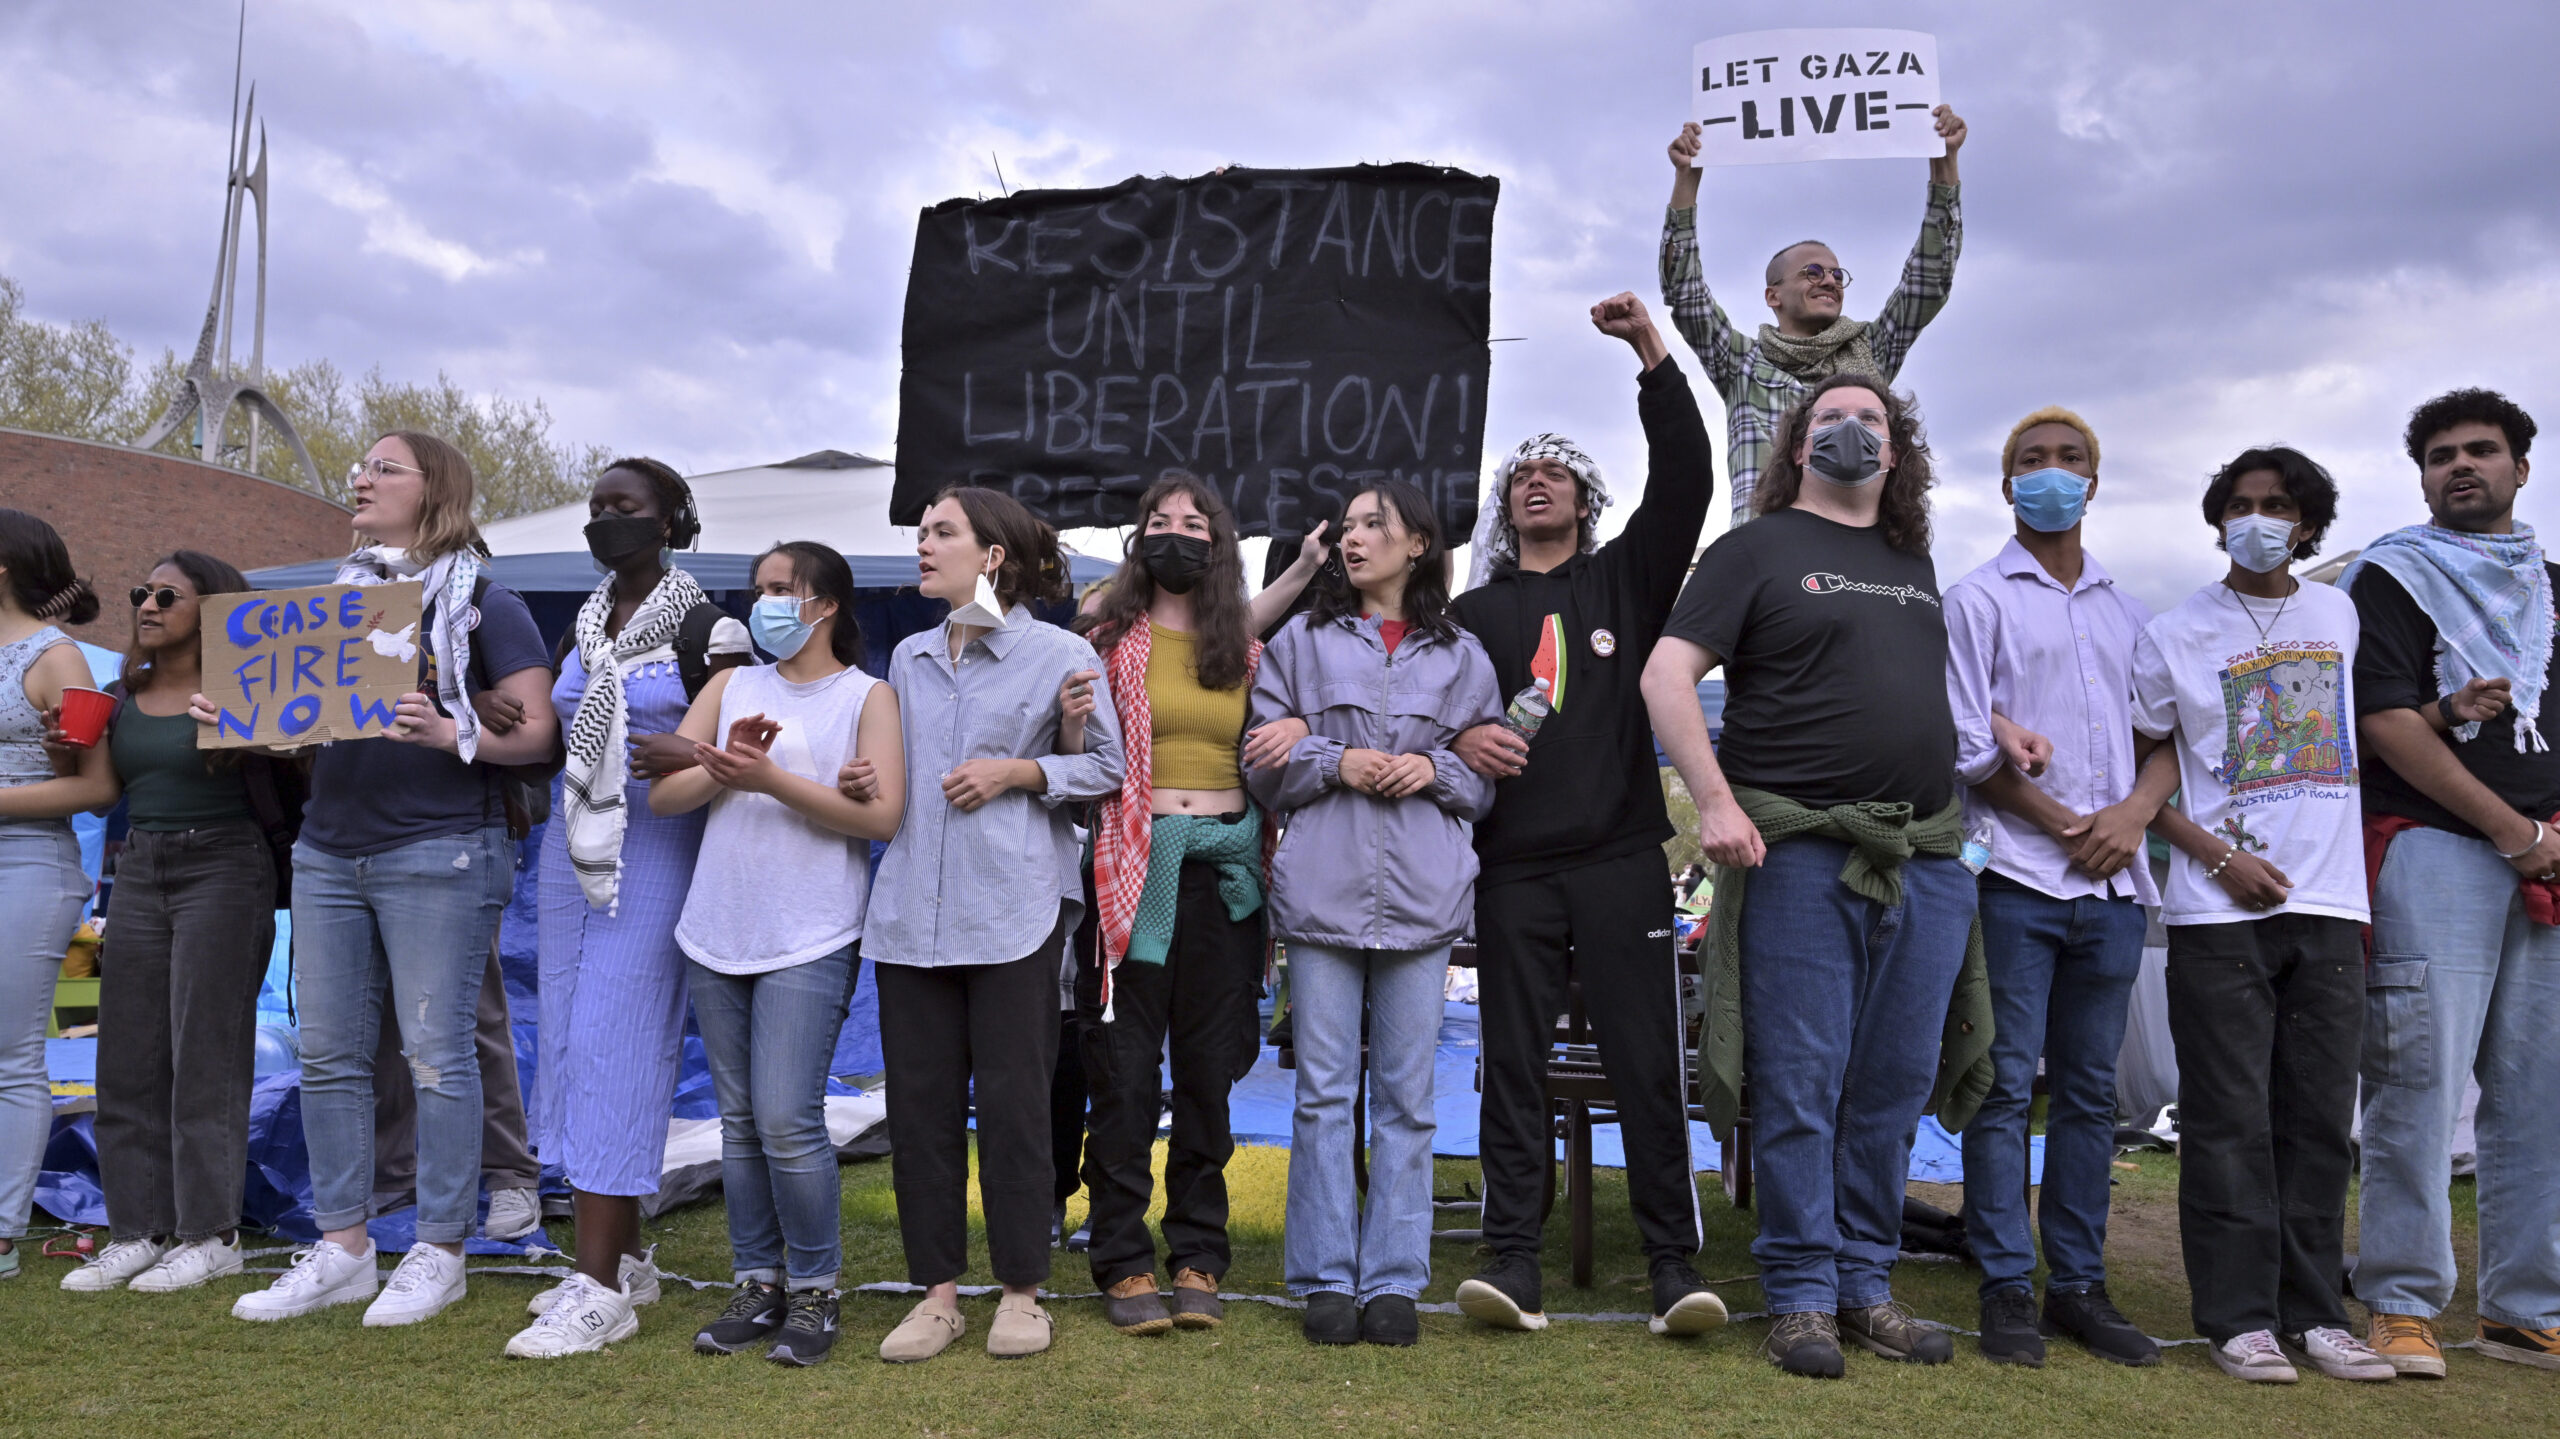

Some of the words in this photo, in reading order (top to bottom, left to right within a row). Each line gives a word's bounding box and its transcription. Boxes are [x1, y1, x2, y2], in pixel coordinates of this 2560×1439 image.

[1702, 56, 1778, 91] LET
[1800, 51, 1925, 80] GAZA
[963, 180, 1493, 291] RESISTANCE
[1047, 281, 1312, 373] UNTIL
[964, 371, 1470, 468] LIBERATION!
[226, 590, 367, 649] CEASE
[232, 637, 364, 706] FIRE
[2225, 649, 2255, 667] SAN
[2303, 640, 2339, 650] ZOO
[217, 693, 401, 741] NOW
[2229, 787, 2306, 808] AUSTRALIA
[581, 1310, 604, 1331] N
